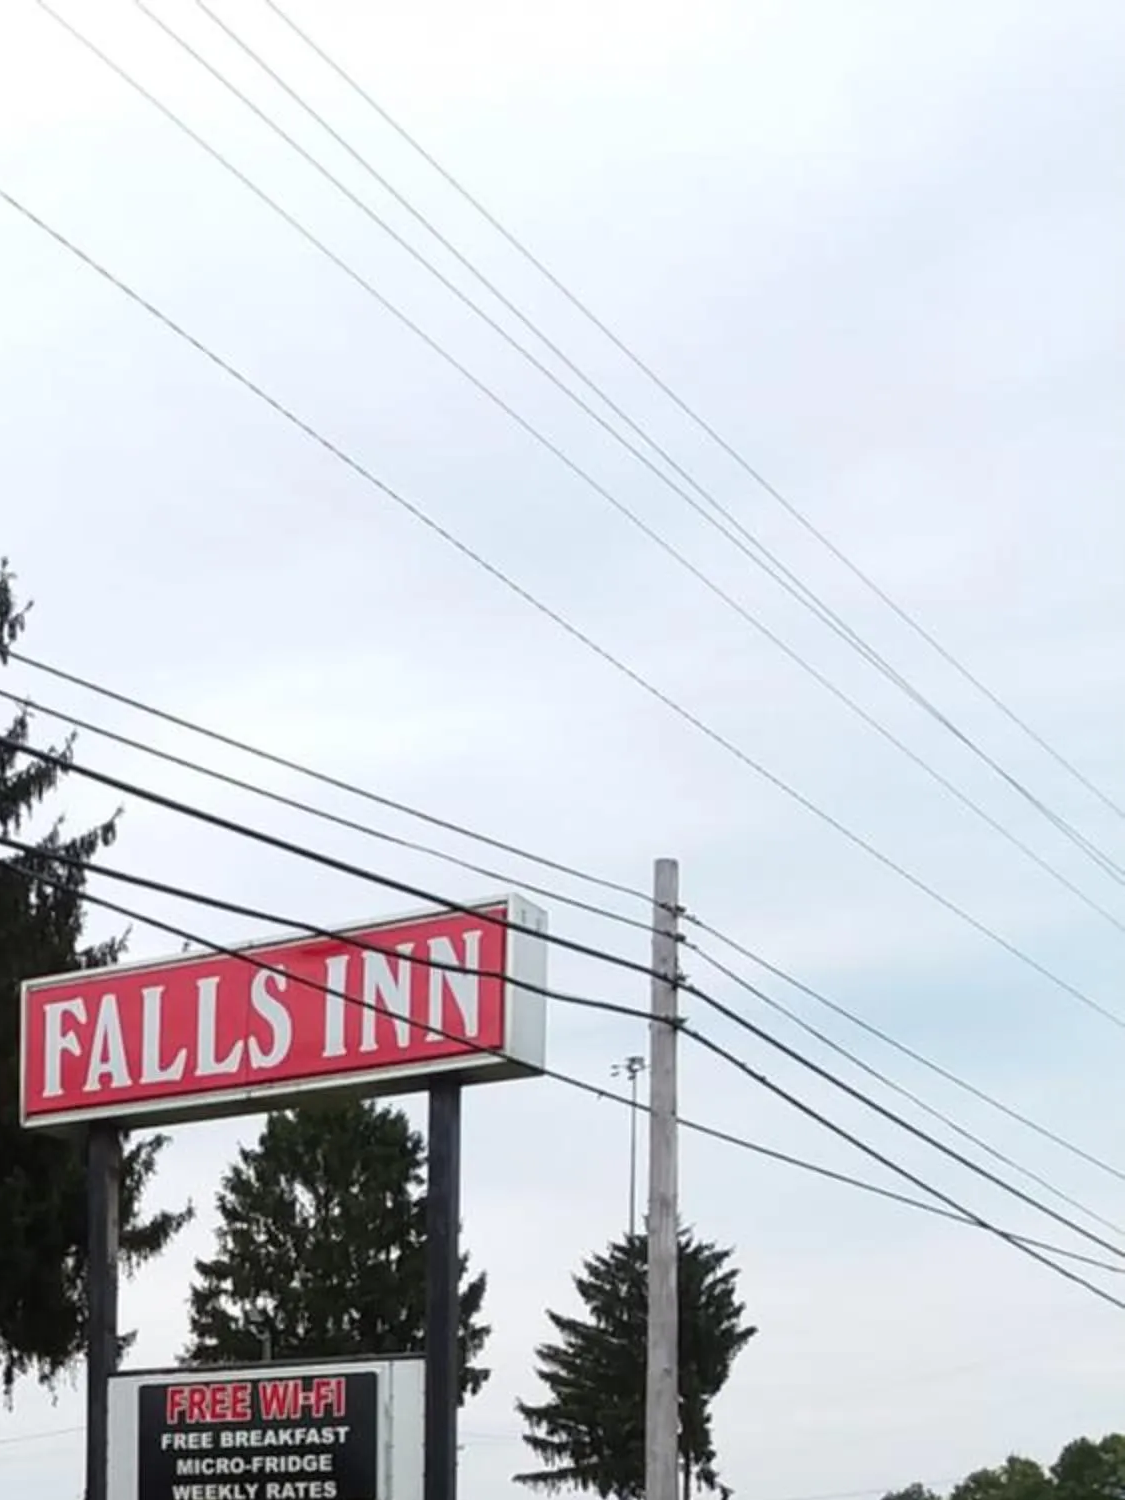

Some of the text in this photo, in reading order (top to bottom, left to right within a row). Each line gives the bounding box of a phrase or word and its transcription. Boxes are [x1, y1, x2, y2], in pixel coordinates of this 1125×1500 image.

[41, 929, 484, 1098] FALLS INN
[166, 1377, 346, 1424] FREE WI-FI
[161, 1426, 350, 1451] FREE BREAKFAST
[176, 1454, 333, 1476] MICRO-FRIDGE
[266, 1480, 338, 1500] RATES
